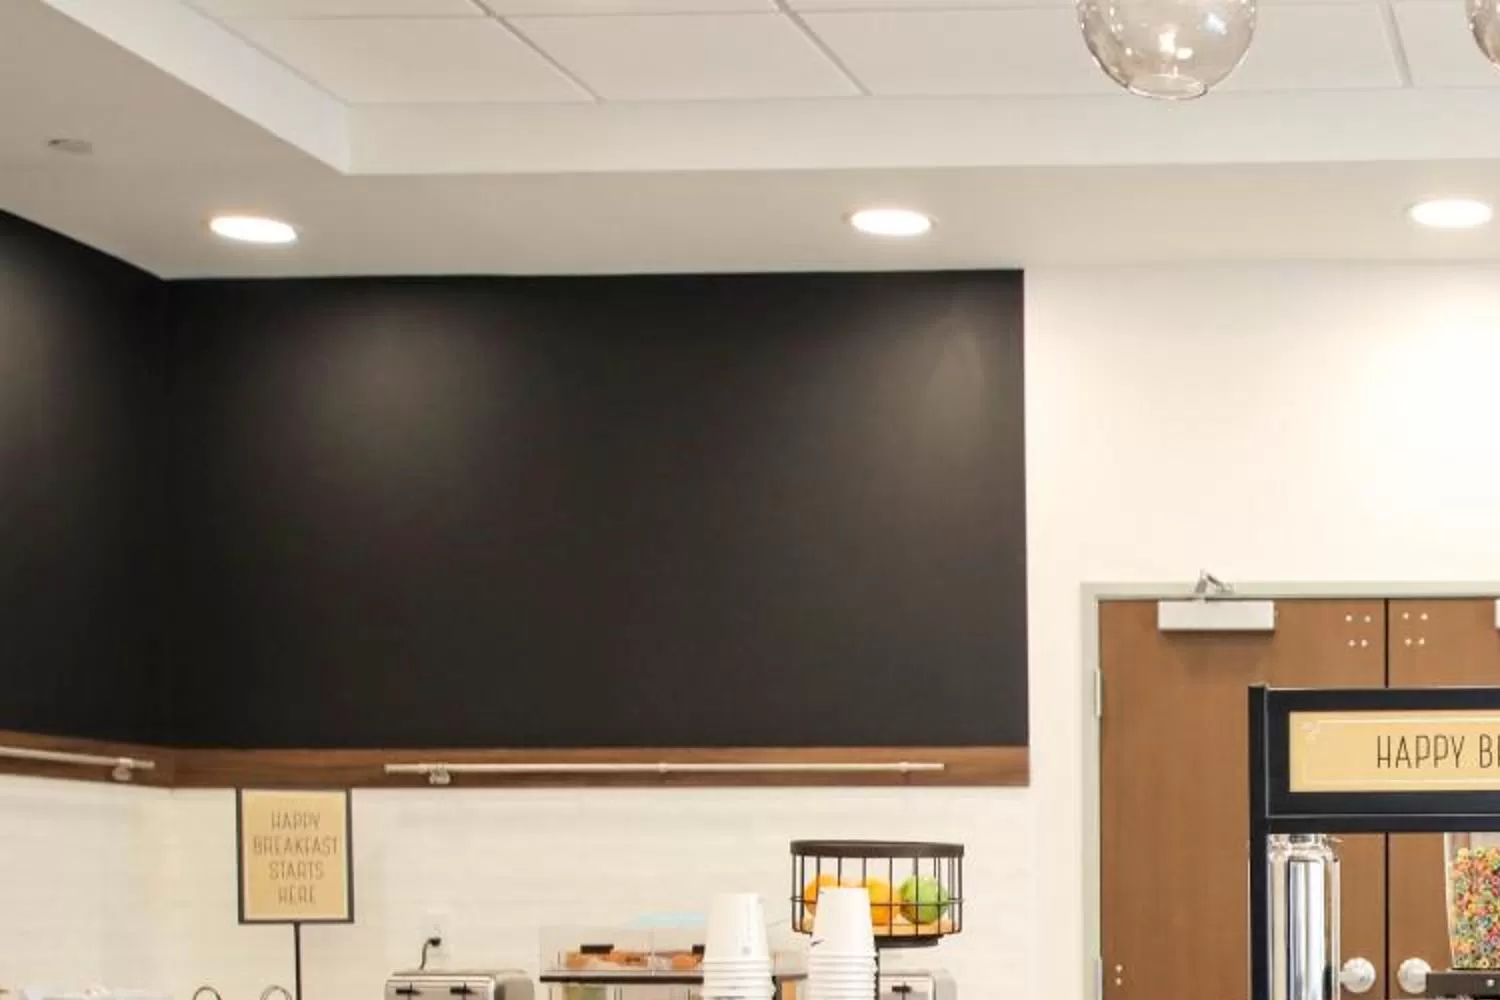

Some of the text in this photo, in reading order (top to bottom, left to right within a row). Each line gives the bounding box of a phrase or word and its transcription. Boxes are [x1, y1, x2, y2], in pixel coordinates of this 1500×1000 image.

[1376, 734, 1466, 769] HAPPY
[271, 811, 321, 831] HAPPY
[253, 835, 338, 857] BREAKFAST
[268, 861, 325, 881] STARTS
[277, 884, 317, 905] HERE
